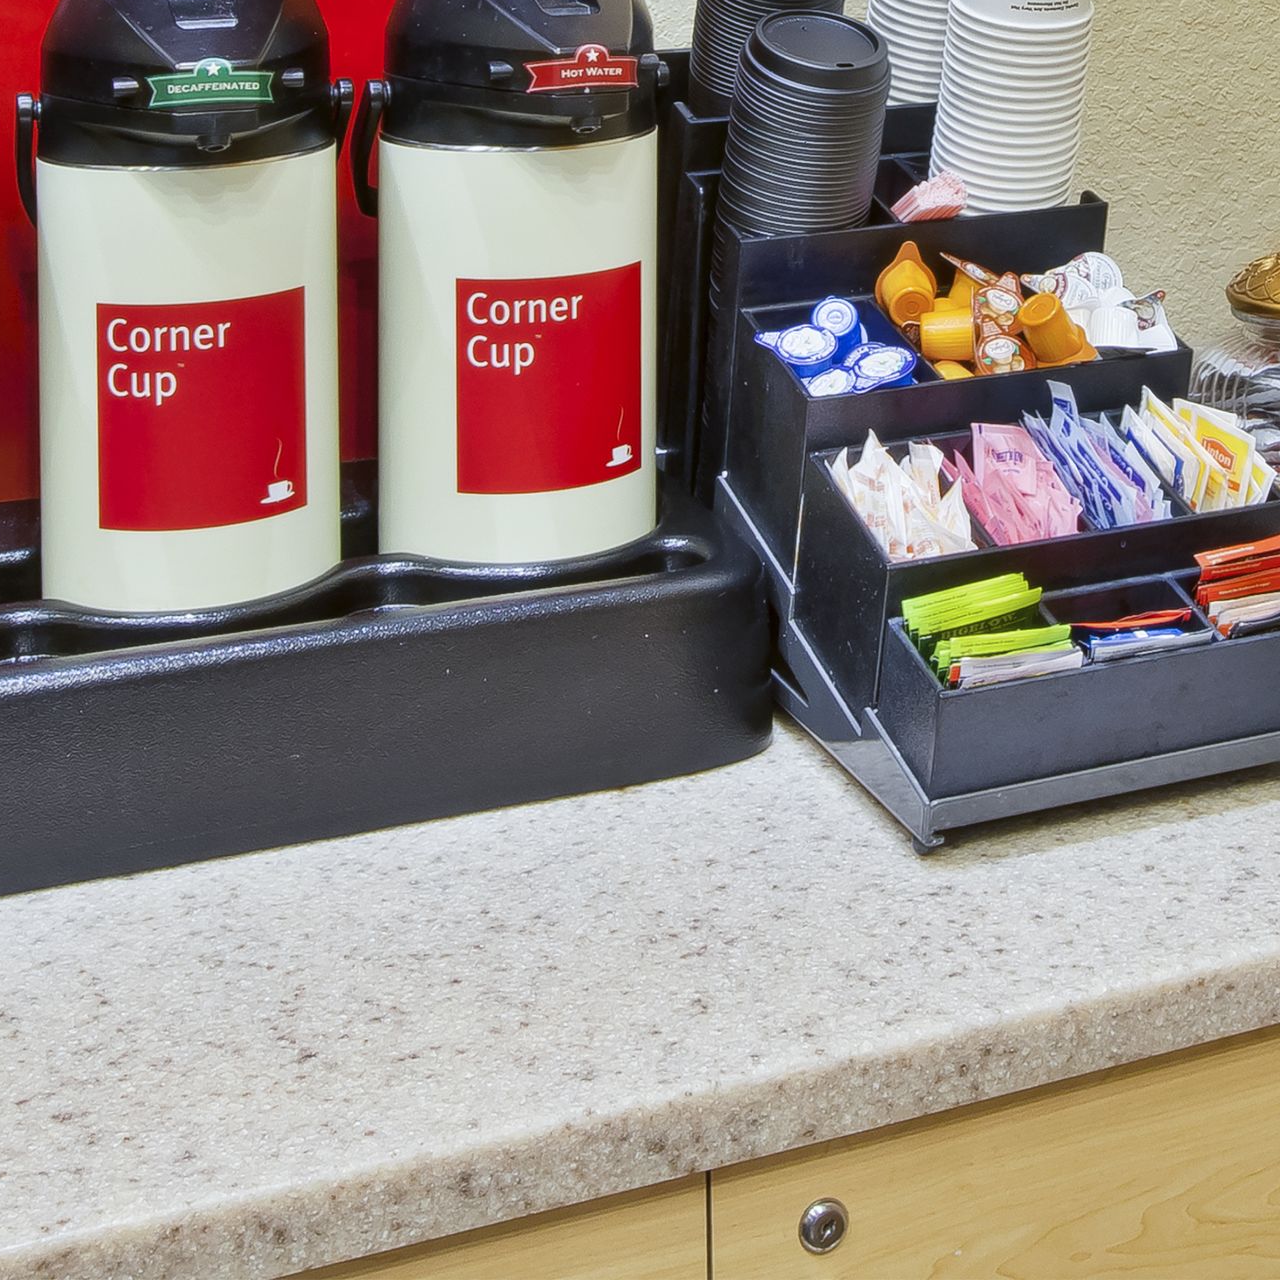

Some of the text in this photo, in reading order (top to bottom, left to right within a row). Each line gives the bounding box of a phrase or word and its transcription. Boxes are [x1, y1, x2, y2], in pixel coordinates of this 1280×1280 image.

[167, 81, 260, 94] DECAFFEINATED
[561, 66, 623, 79] HOT WATER
[466, 291, 584, 325] Corner
[106, 317, 232, 353] Corner
[466, 334, 535, 376] Cup
[107, 362, 177, 407] Cup
